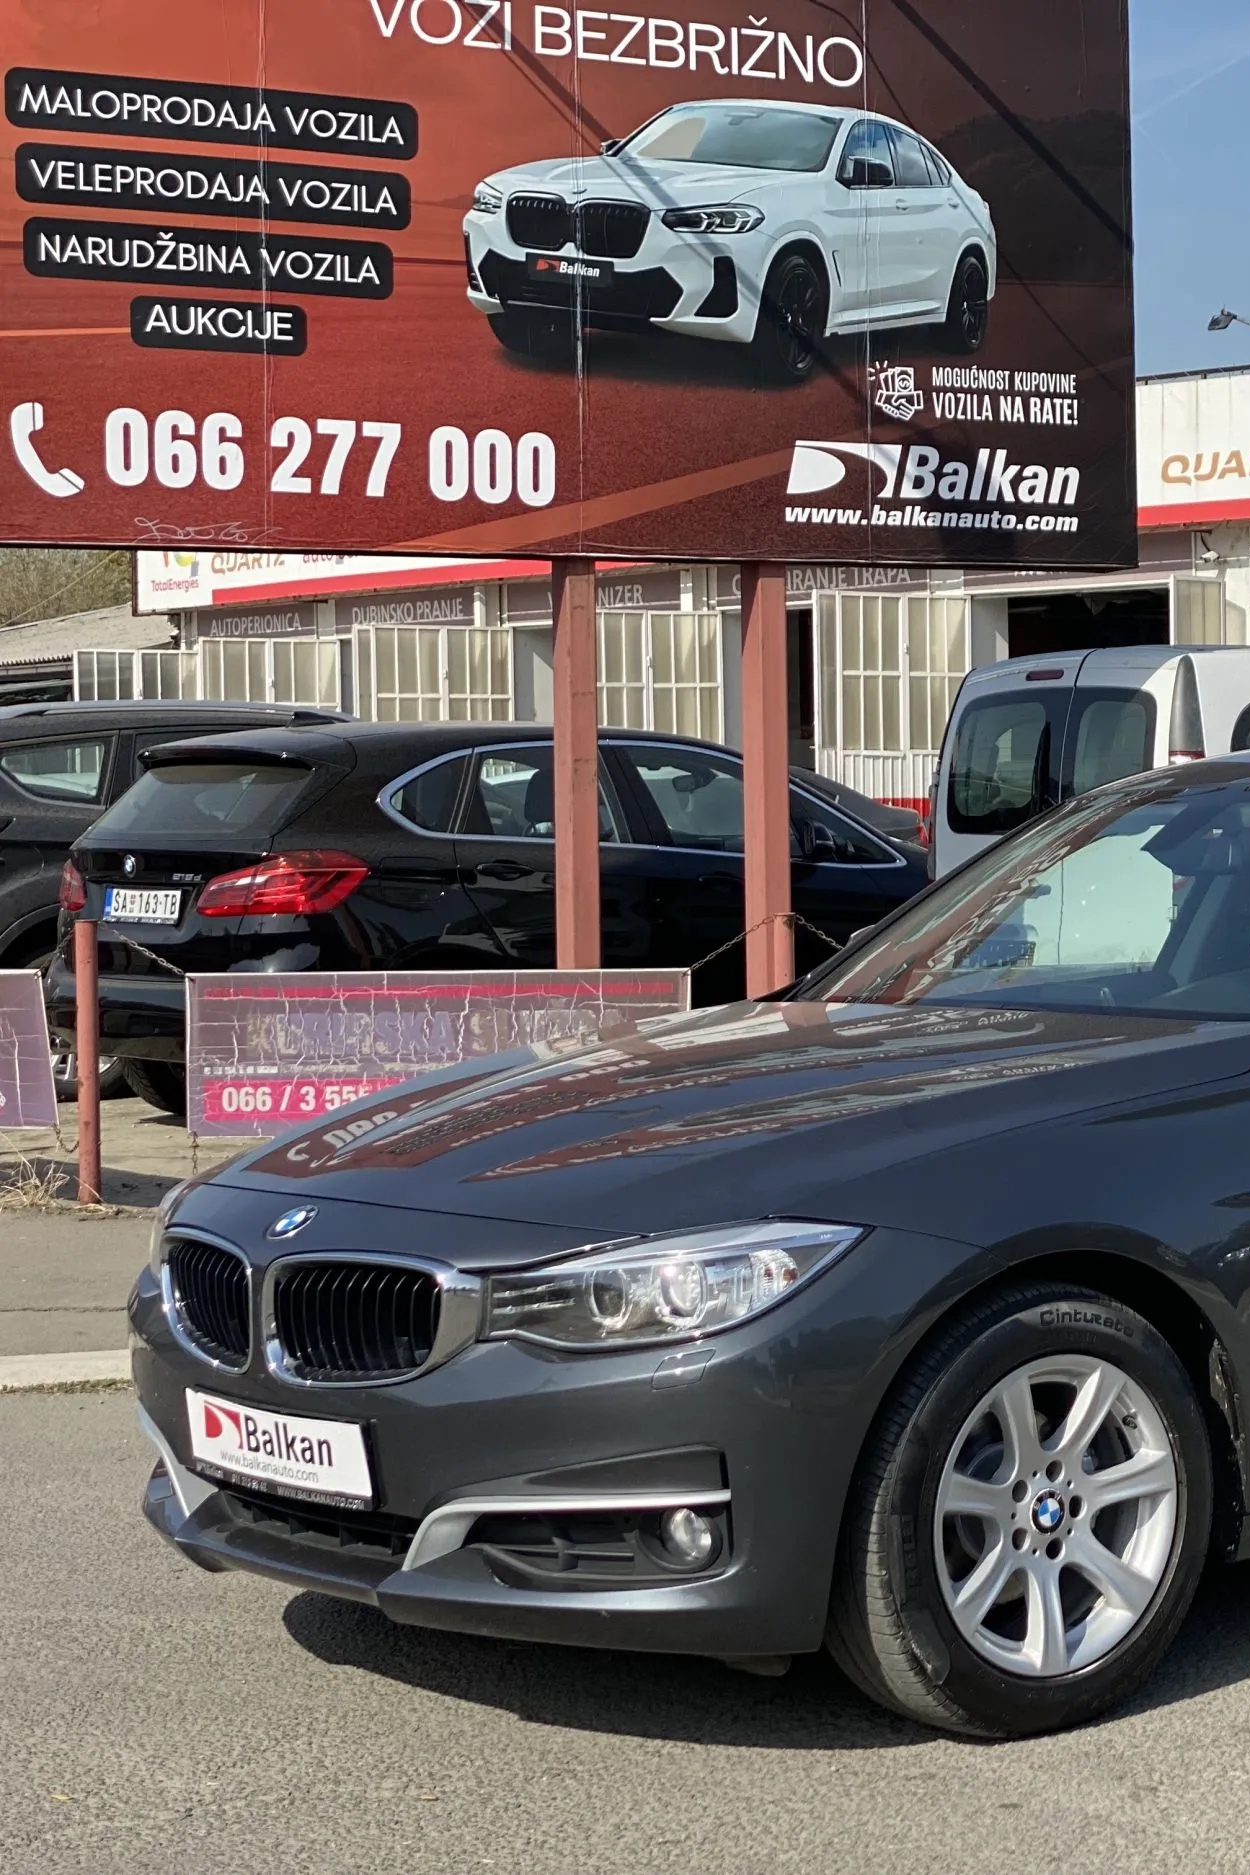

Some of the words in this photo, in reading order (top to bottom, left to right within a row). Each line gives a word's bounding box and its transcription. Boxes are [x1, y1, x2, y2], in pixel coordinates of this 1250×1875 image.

[370, 0, 512, 51] VOZI
[535, 5, 864, 87] BEZBRIŽNO
[18, 84, 276, 133] MALOPRODAJA
[285, 106, 405, 145] VOZILA
[30, 159, 270, 204] VELEPRODAJA
[277, 177, 398, 216] VOZILA
[38, 231, 251, 275] NARUDŽBINA
[260, 248, 380, 285] VOZILA
[560, 261, 600, 277] Balkan
[145, 305, 294, 341] AUKCIJE
[932, 365, 1010, 390] MOGUĆNOST
[1014, 372, 1077, 394] KUPOVINE
[932, 392, 993, 421] VOZILA
[1000, 395, 1025, 423] NA
[1029, 397, 1079, 425] RATE!
[105, 407, 245, 491] 066
[270, 416, 402, 498] 277
[428, 426, 556, 507] 000
[900, 444, 1080, 505] Balkan
[785, 504, 1079, 532] www.balkanauto.com
[151, 578, 199, 592] TotalEnergies
[210, 612, 301, 637] AUTOPERIONICA
[352, 602, 413, 625] DUBINSKO
[416, 598, 463, 621] PRANJE
[114, 890, 127, 912] SA
[222, 1086, 272, 1112] 066
[300, 1086, 316, 1112] 3
[1040, 1308, 1134, 1338] Cinturato
[244, 1414, 333, 1467] Balkan
[220, 1449, 320, 1484] www.balkanauto.com
